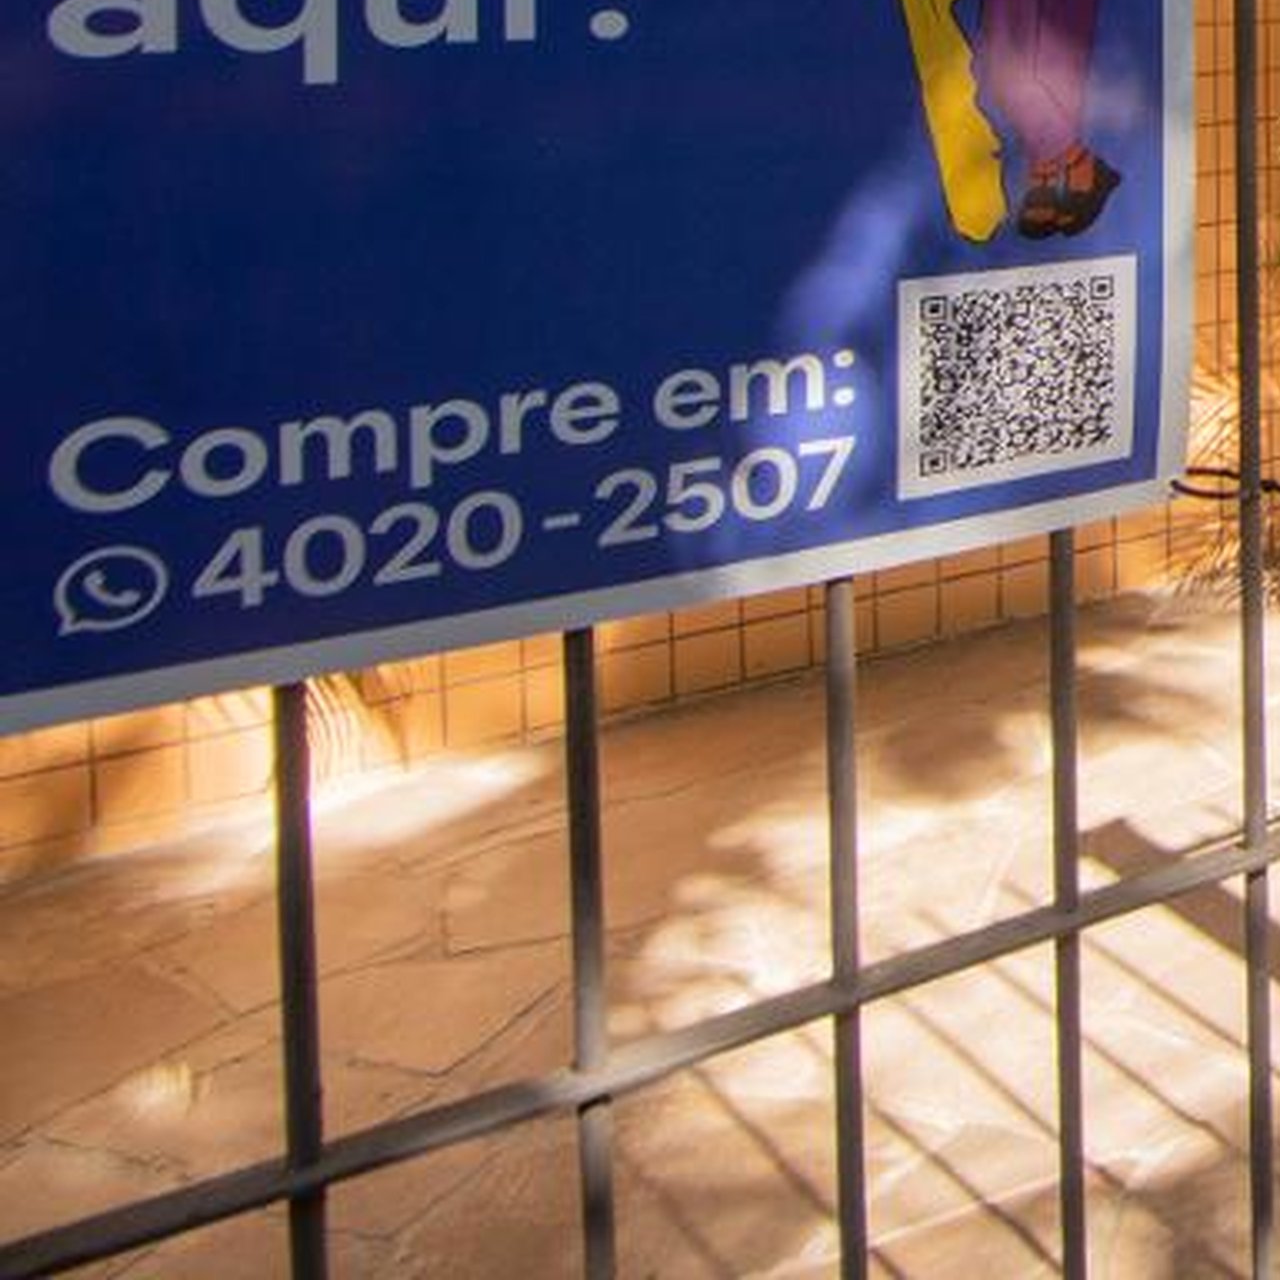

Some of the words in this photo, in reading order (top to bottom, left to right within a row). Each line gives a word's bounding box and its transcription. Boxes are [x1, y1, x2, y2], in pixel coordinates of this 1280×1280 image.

[47, 379, 620, 516] Compre
[652, 345, 857, 430] em:
[191, 435, 857, 610] 4020-2507
